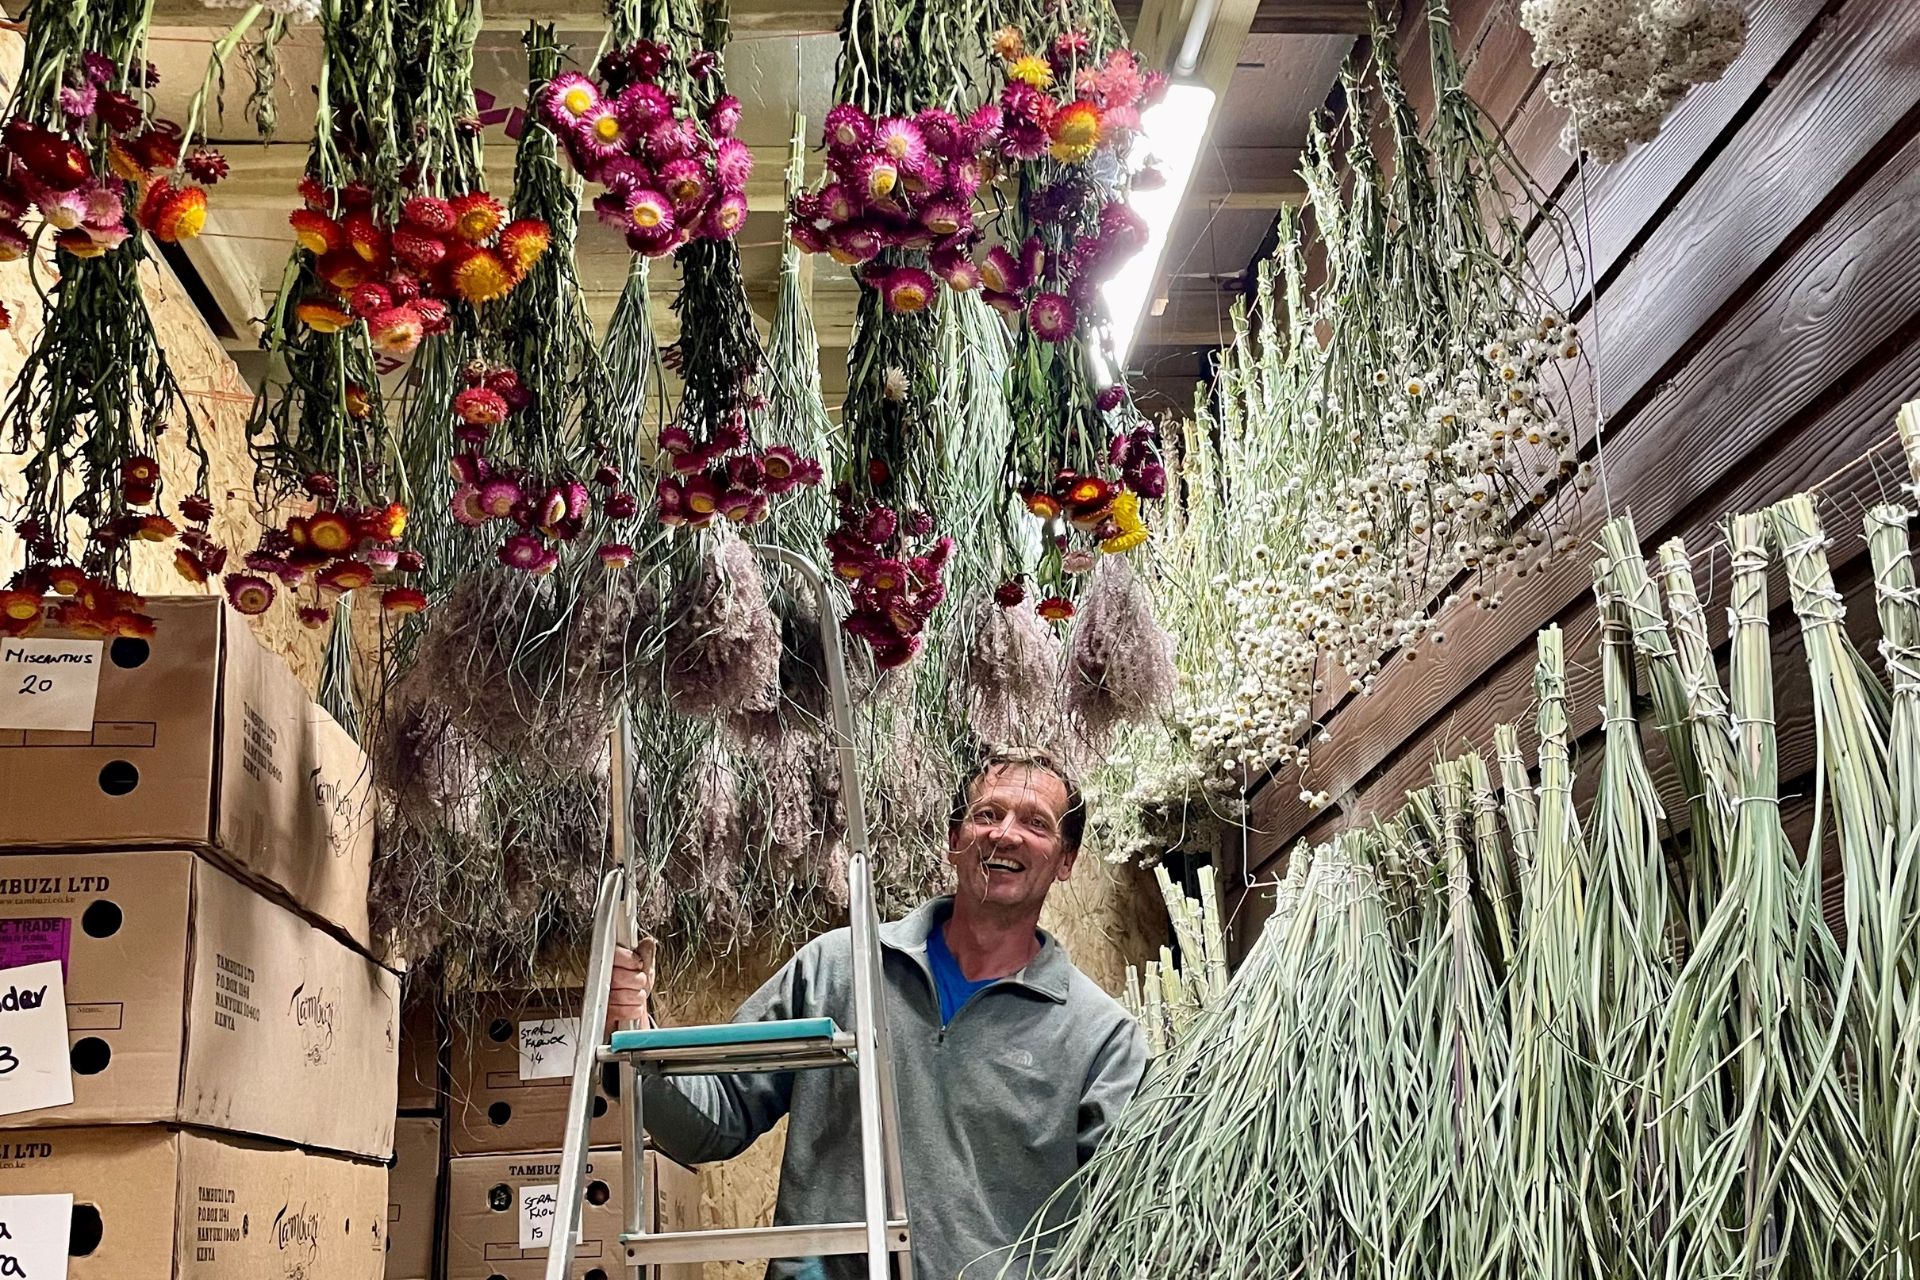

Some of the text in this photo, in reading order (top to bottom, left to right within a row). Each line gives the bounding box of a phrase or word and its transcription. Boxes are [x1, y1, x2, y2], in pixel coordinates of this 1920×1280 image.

[18, 674, 53, 695] 20
[67, 876, 110, 893] LTD
[14, 918, 61, 933] TRADE
[0, 985, 48, 1012] der
[214, 1010, 236, 1031] KENYA
[531, 1051, 544, 1064] 14
[15, 1143, 52, 1159] LTD
[508, 1164, 561, 1176] TAMBUZ
[524, 1193, 557, 1211] STRA
[531, 1226, 543, 1241] 15
